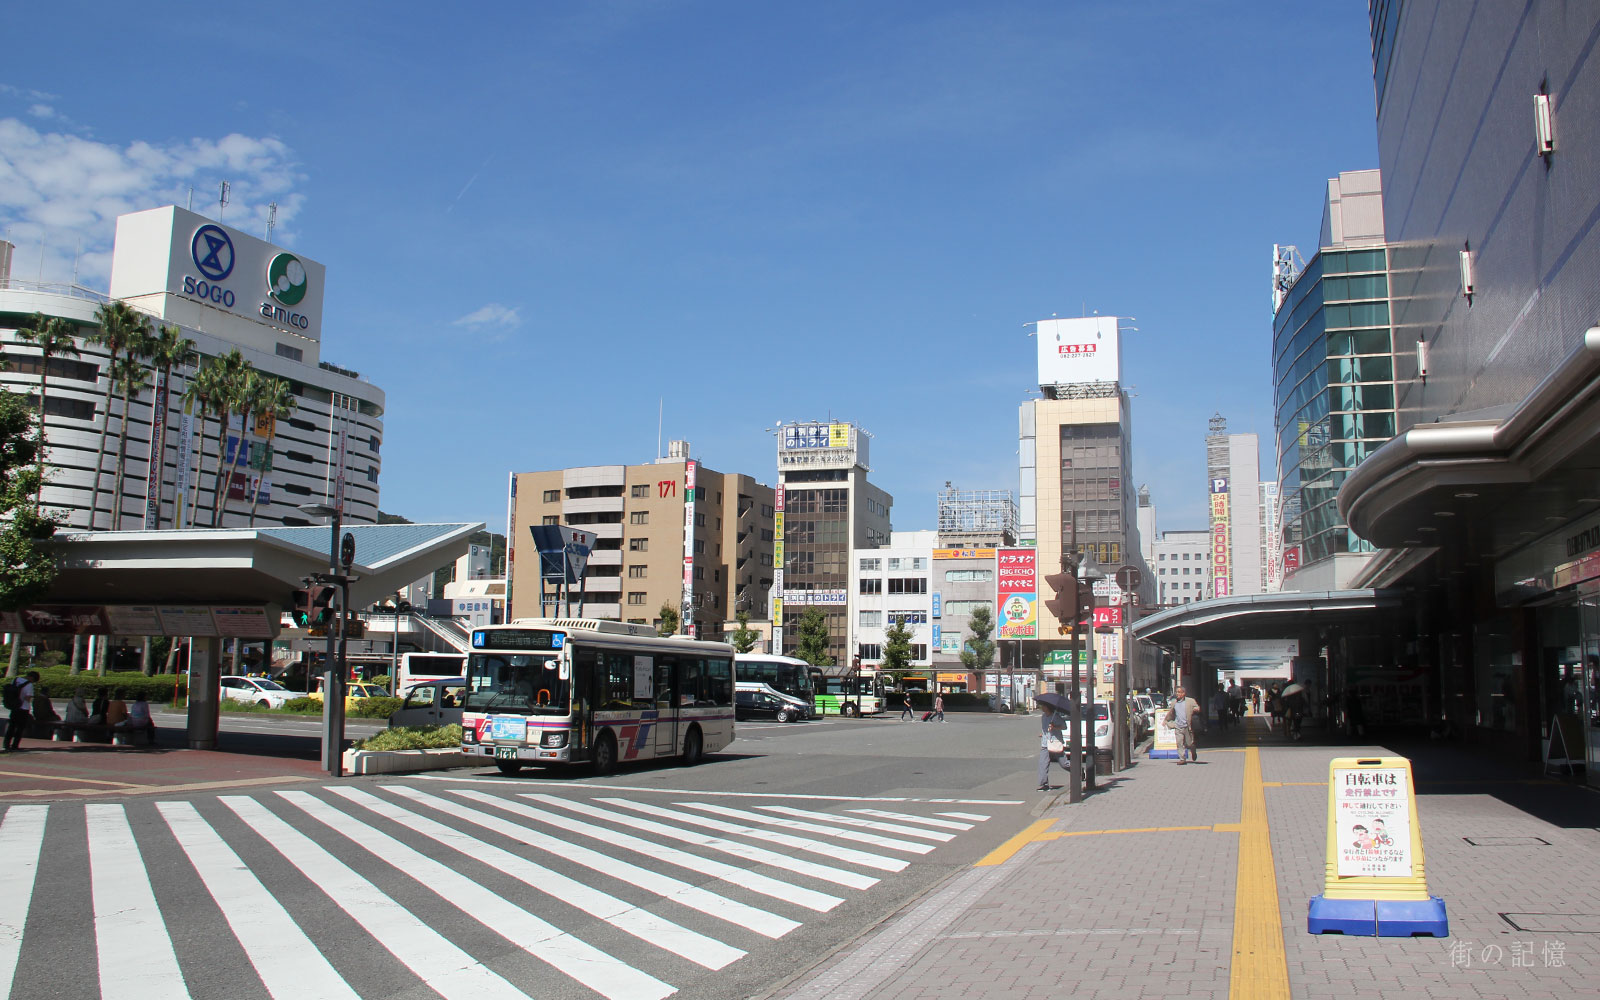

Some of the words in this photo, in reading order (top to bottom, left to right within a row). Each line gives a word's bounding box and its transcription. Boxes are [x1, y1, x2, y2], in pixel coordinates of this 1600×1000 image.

[183, 275, 235, 307] SOGO
[260, 302, 308, 329] amico
[1060, 344, 1095, 352] 広告募集
[786, 427, 829, 437] 個別教室
[786, 438, 829, 447] のトライ
[658, 480, 676, 498] 171
[1214, 480, 1225, 493] P
[1346, 773, 1397, 786] 自転車は
[1345, 788, 1398, 797] 走行禁止です
